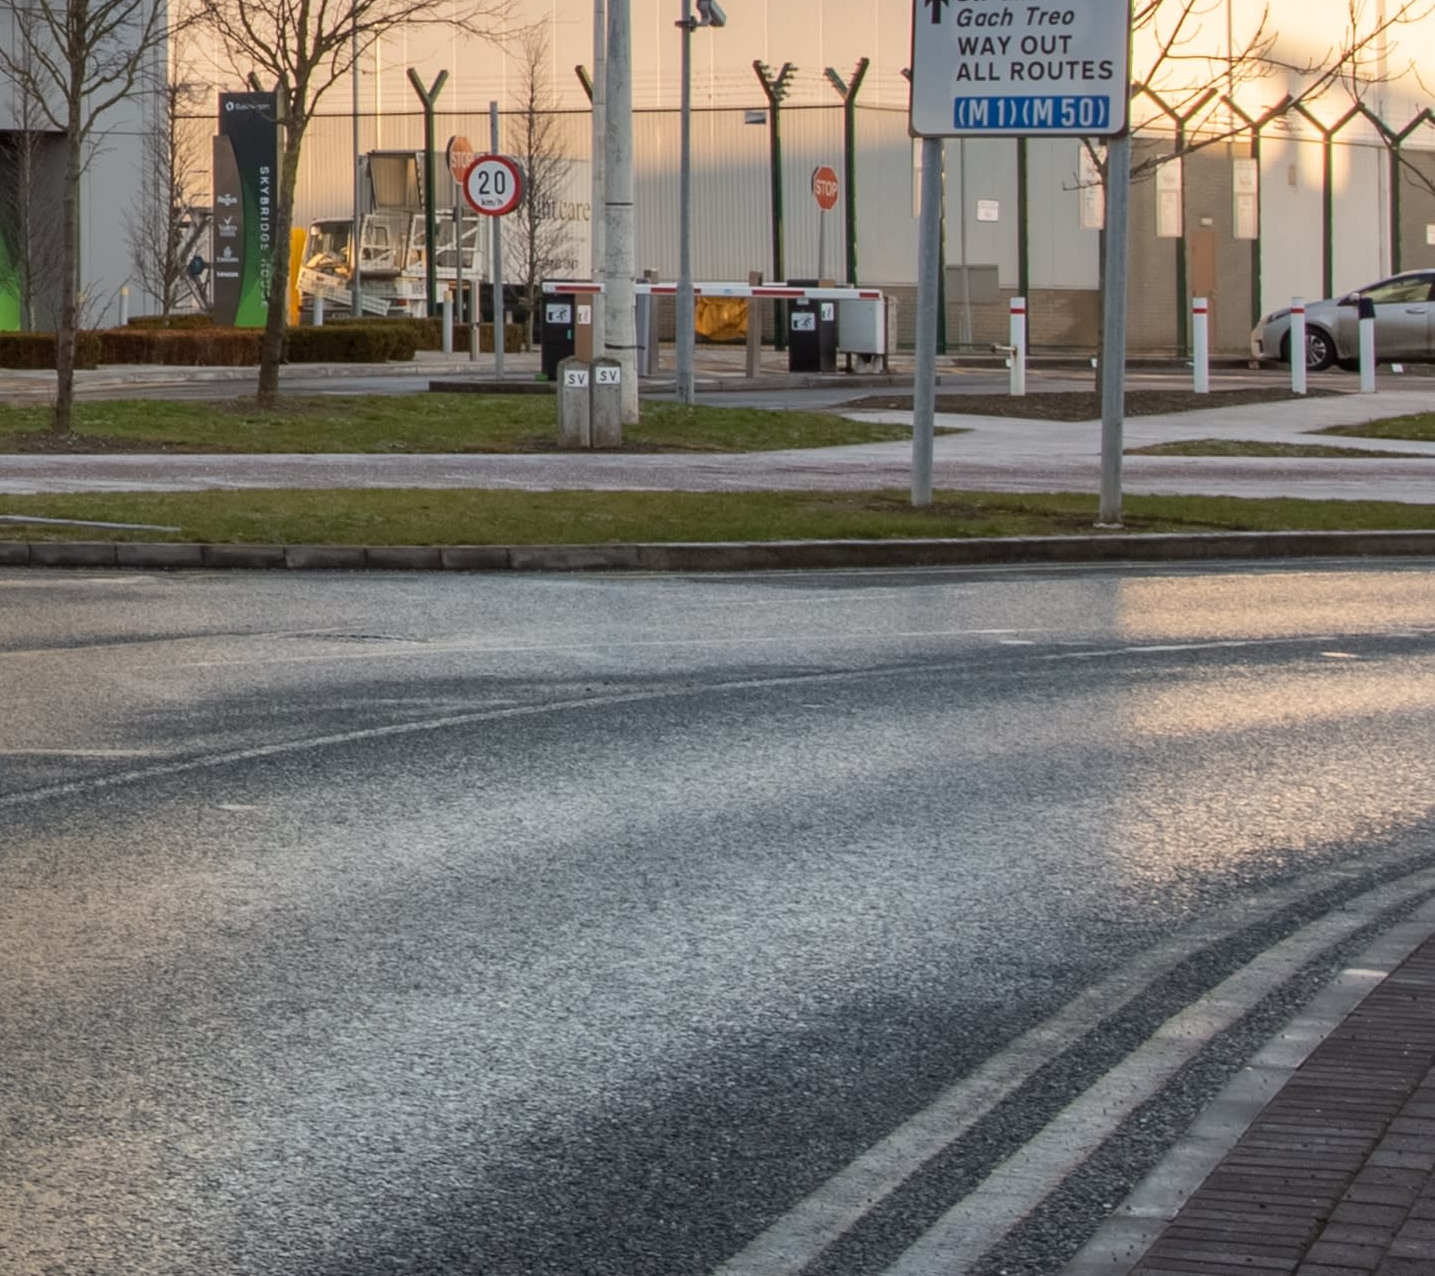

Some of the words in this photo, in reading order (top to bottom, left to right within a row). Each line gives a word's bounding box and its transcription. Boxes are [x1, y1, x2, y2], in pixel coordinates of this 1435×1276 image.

[956, 6, 1014, 28] Gach
[1026, 6, 1075, 26] Treo
[957, 36, 1011, 56] WAY
[1020, 34, 1073, 55] OUT
[956, 62, 1000, 82] ALL
[1010, 60, 1114, 81] ROUTES
[478, 170, 505, 195] 20
[814, 179, 838, 197] STOP
[259, 166, 270, 250] SKYBRIDGE
[568, 373, 586, 385] SV
[599, 370, 617, 381] SV
